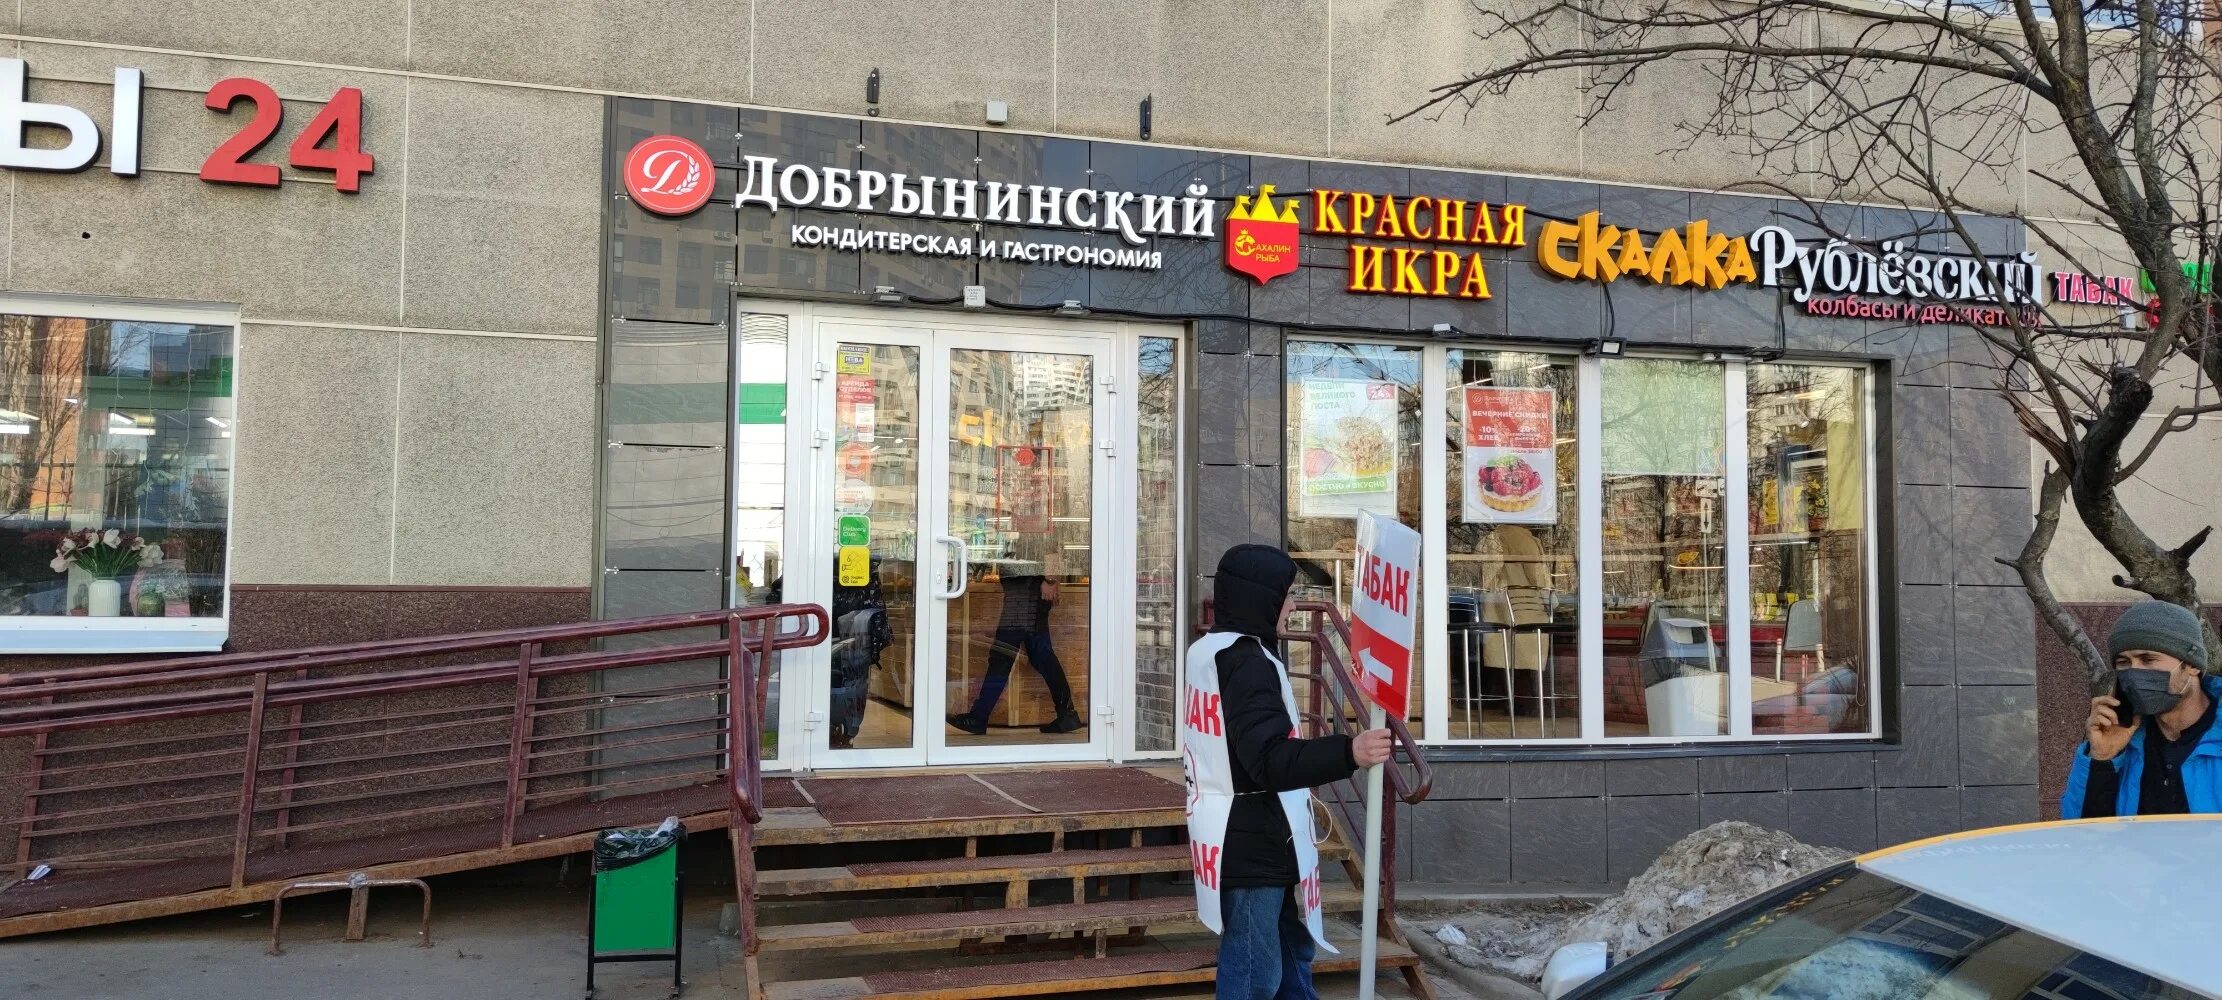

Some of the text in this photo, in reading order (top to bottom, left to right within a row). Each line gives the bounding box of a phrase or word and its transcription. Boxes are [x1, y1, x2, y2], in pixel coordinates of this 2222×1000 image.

[200, 77, 374, 194] 24
[735, 155, 1215, 245] ДОБРЫНИНСКИЙ
[1315, 189, 1527, 246] КРАСНАЯ
[791, 224, 1162, 269] КОНДИТЕРСКАЯ И ГАСТРОНОМИЯ
[1255, 254, 1280, 262] РЫБА
[1350, 244, 1492, 299] ИКРА
[1538, 210, 1757, 290] СКАЛКА
[1750, 225, 2042, 305] Рублёвский
[1807, 295, 1898, 319] колбасы
[1903, 302, 1917, 320] и
[2054, 271, 2134, 306] ТАБАК
[1311, 391, 1356, 400] ВЕЛИКОГО
[1311, 401, 1341, 410] ПОСТА
[1357, 544, 1410, 617] ТАБАК
